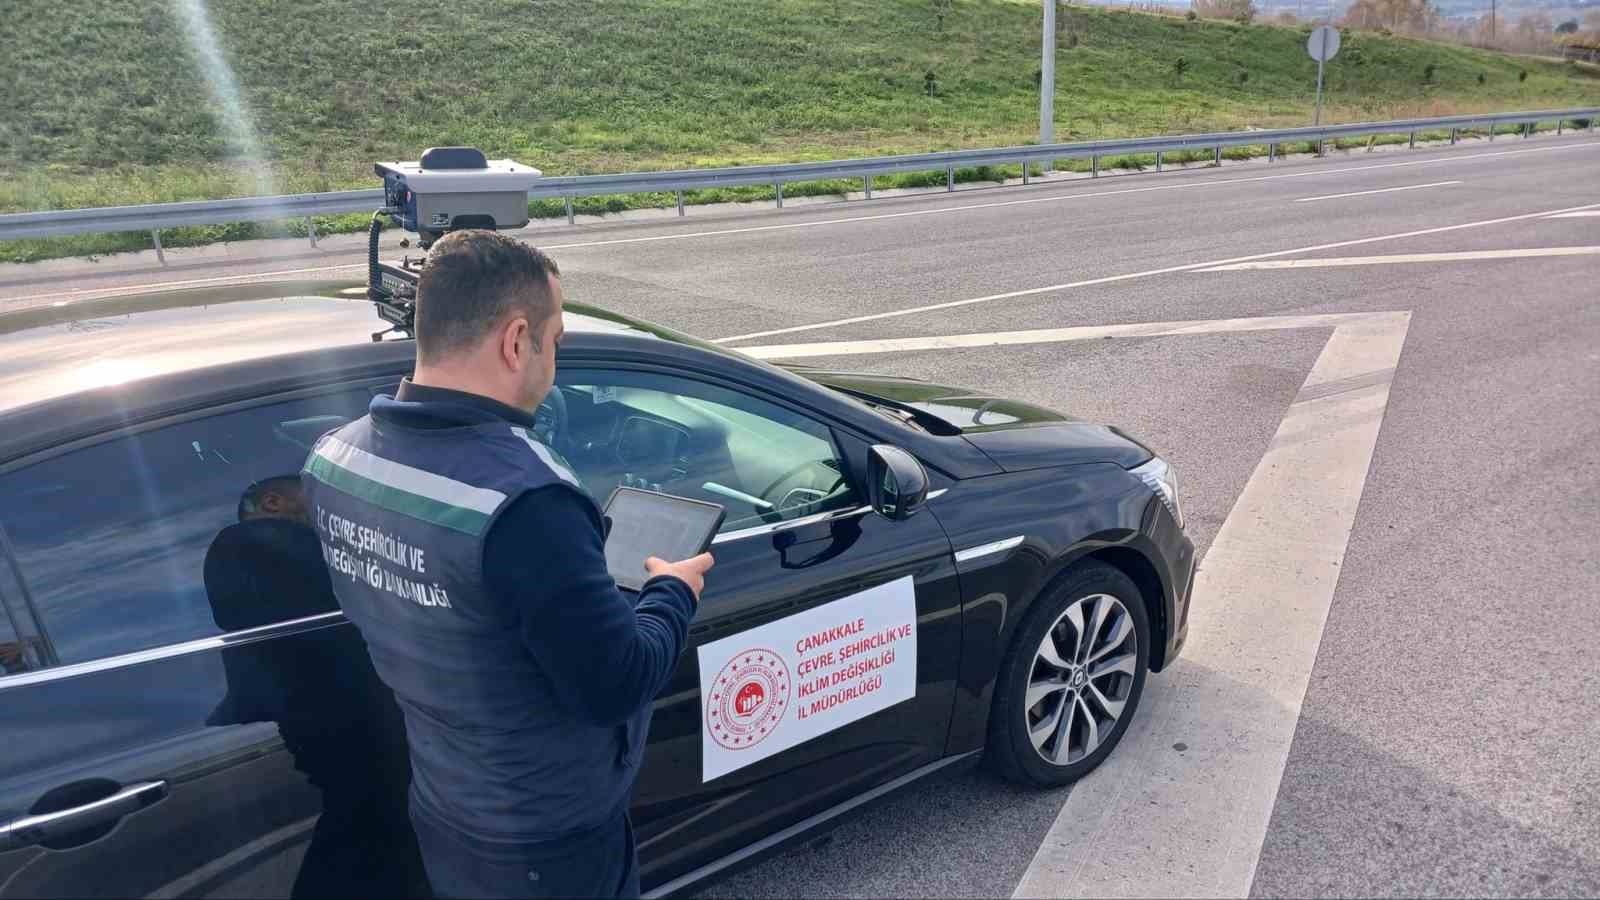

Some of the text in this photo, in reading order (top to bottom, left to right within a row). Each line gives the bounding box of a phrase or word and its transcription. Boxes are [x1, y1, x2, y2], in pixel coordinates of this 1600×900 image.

[409, 545, 425, 573] VE
[796, 618, 865, 657] ÇANAKKALE
[797, 623, 912, 679] ÇEVRE, ŞEHİRCİLİK VE
[798, 648, 895, 698] İKLİM DEĞİŞİKLİĞİ
[798, 704, 808, 720] İL
[810, 673, 882, 714] MÜDÜRLÜĞÜ
